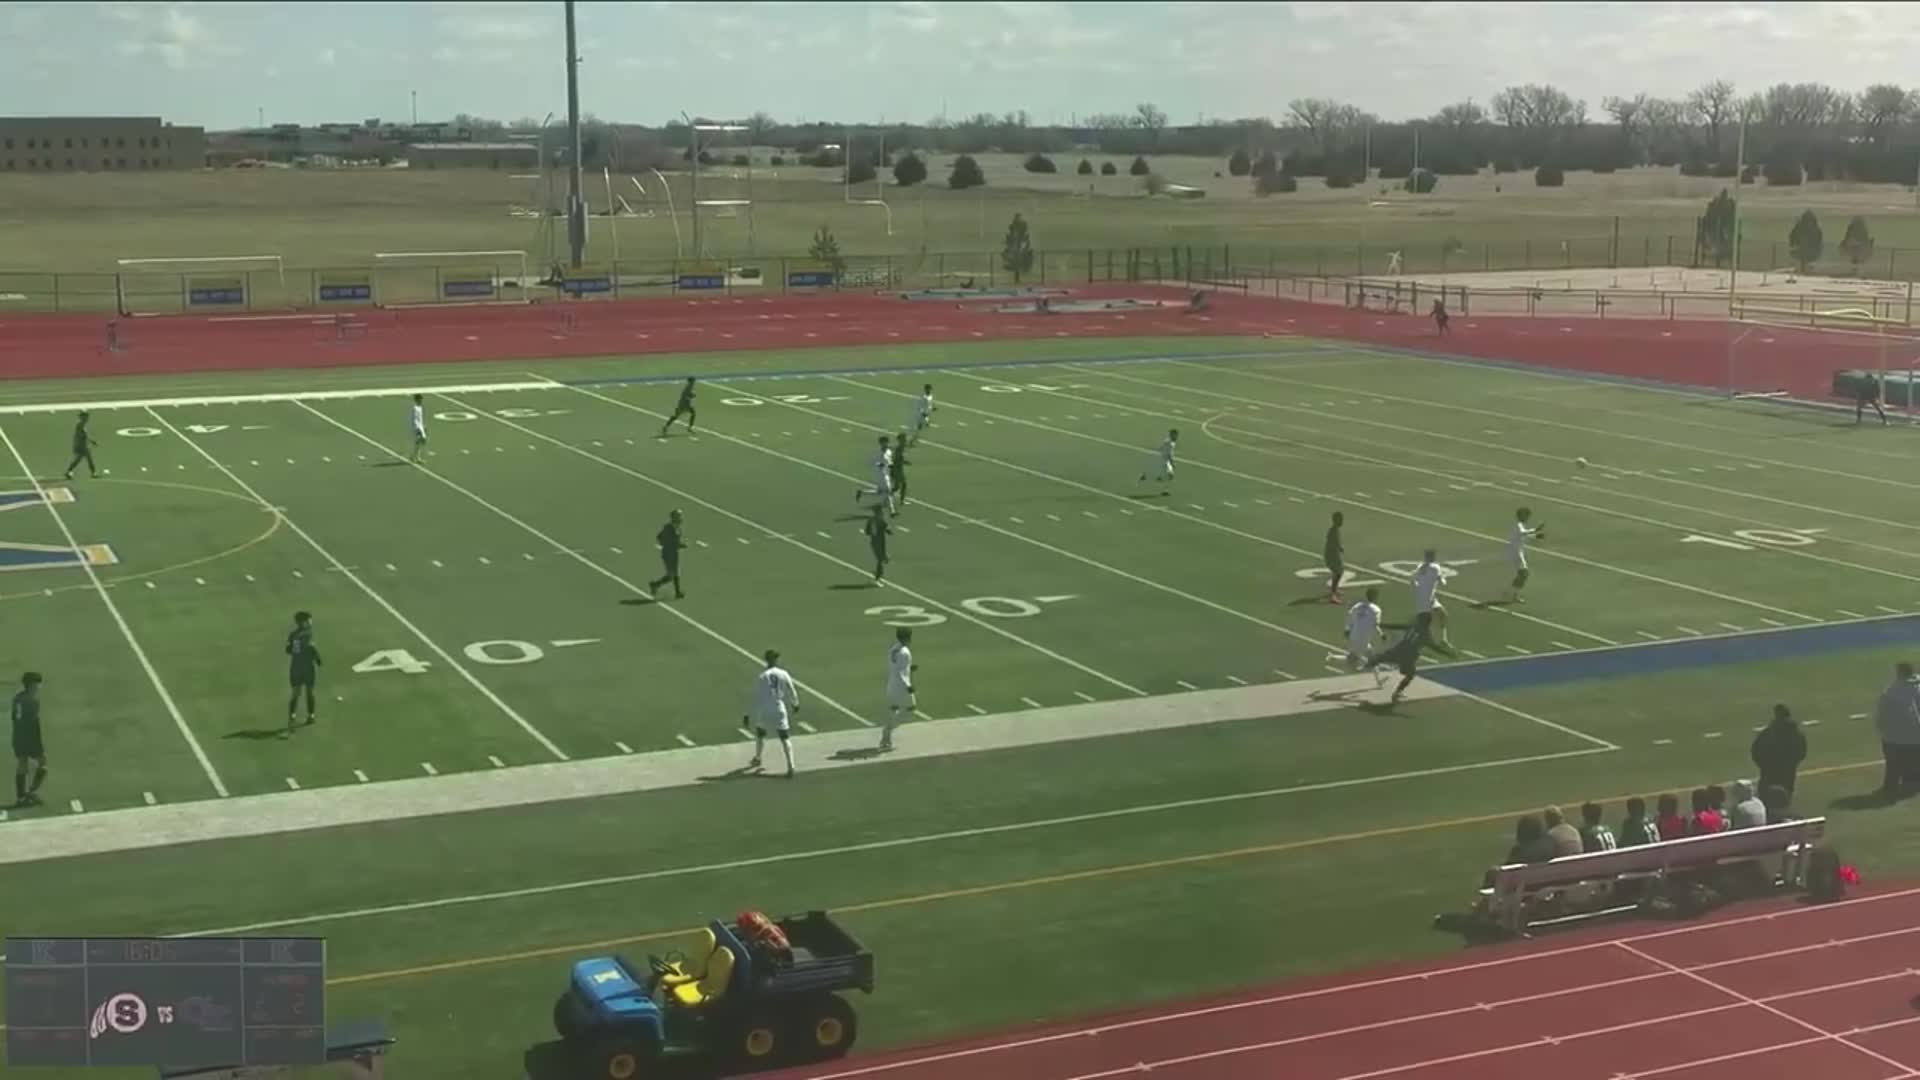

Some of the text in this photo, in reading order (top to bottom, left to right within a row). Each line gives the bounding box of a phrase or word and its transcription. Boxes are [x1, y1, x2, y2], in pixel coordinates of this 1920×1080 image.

[1679, 529, 1817, 551] 10
[863, 596, 1042, 627] 30
[351, 639, 545, 674] 40
